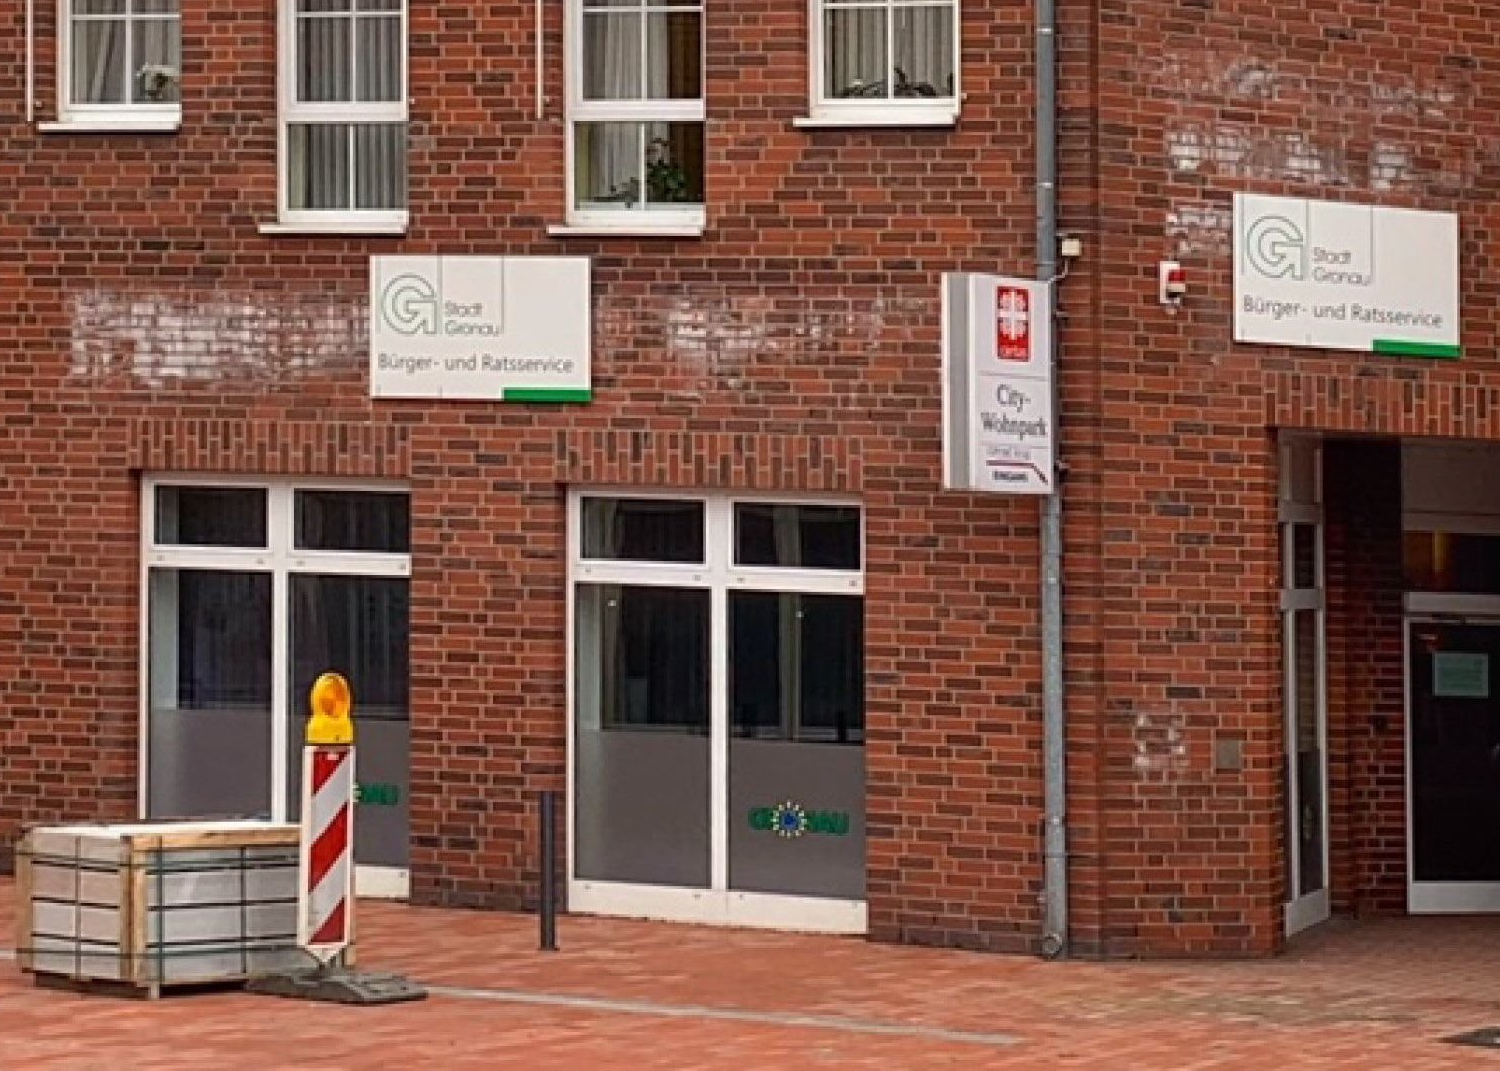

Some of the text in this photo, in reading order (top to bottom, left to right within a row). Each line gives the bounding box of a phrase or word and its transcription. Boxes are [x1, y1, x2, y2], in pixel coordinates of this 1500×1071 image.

[1243, 294, 1443, 328] Bürger- und Ratsservice
[377, 353, 574, 374] Bürger- und Ratsservice
[996, 383, 1032, 413] City-
[980, 412, 1047, 441] Wohnpark
